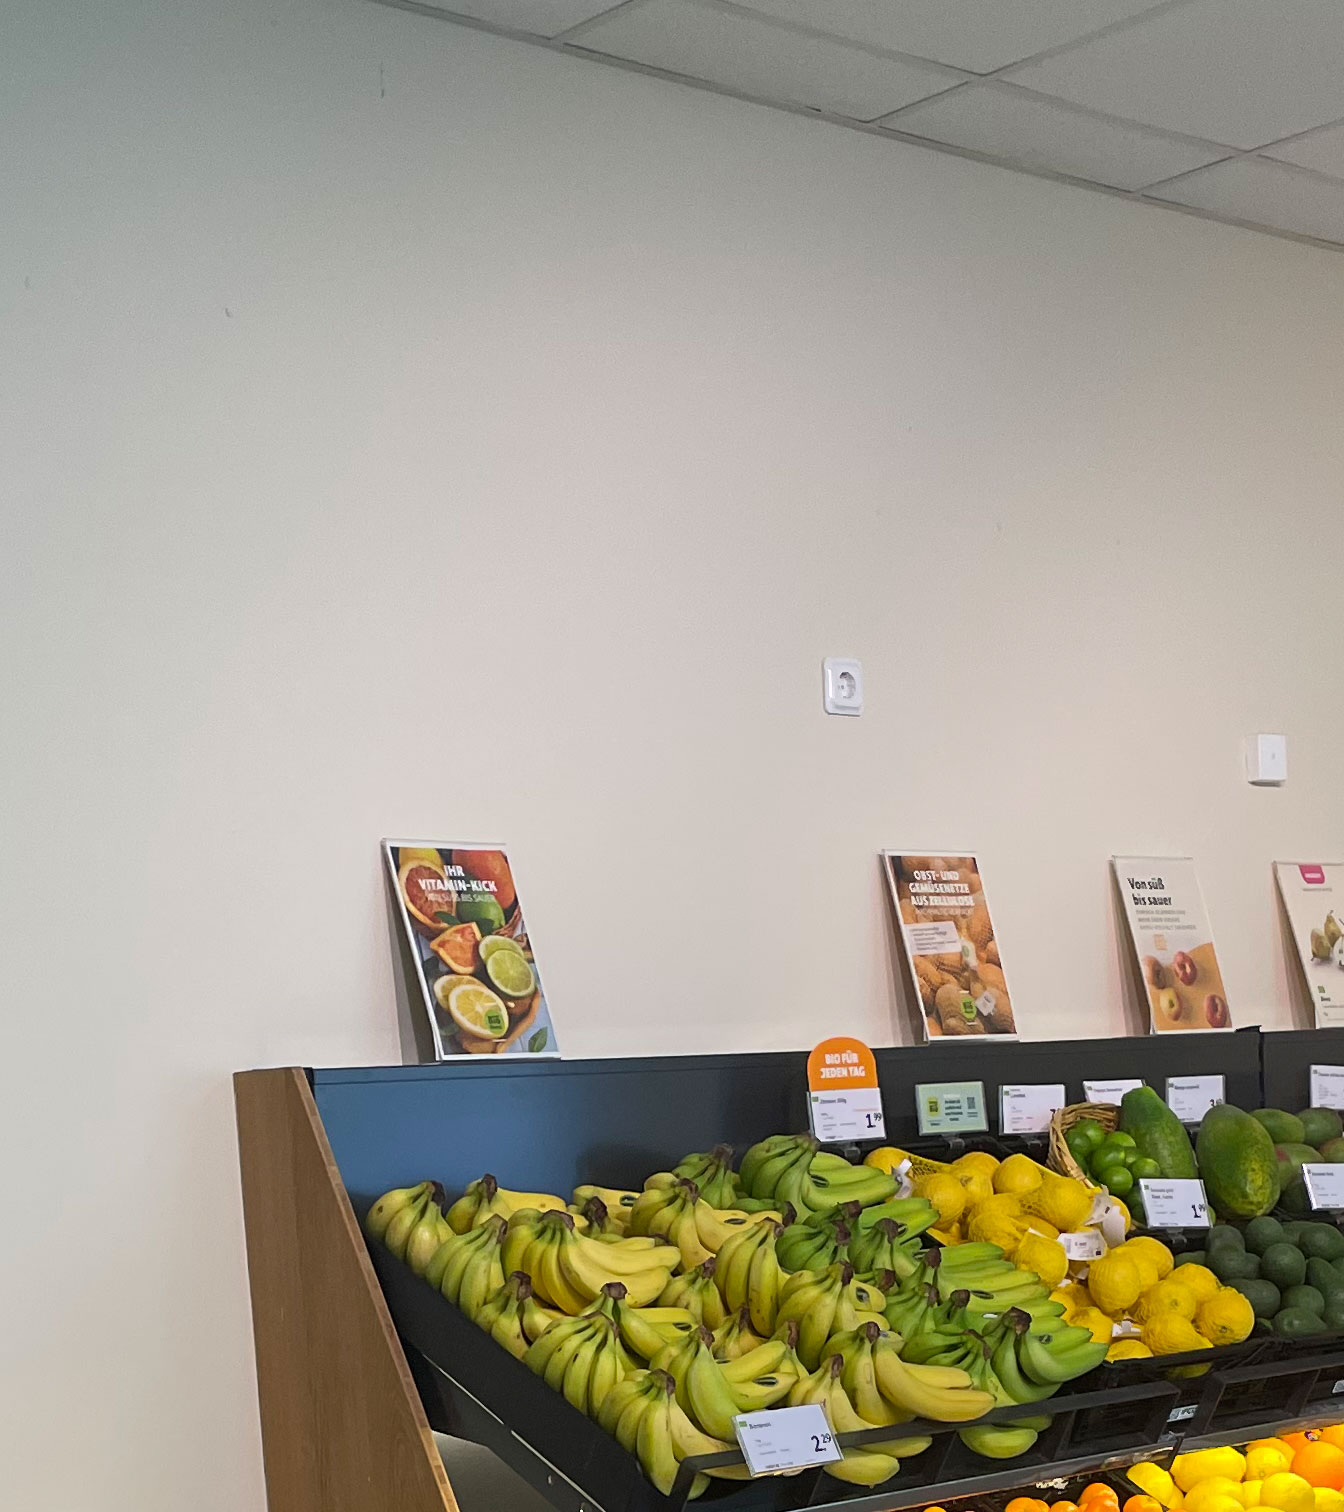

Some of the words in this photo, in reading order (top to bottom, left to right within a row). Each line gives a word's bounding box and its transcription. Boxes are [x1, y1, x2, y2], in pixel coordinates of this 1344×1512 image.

[443, 865, 465, 877] IHR
[913, 870, 940, 881] OBST-
[940, 870, 959, 881] UND
[418, 878, 498, 892] VITAMIN-KICK
[1127, 878, 1147, 890] Von
[1148, 877, 1165, 890] süß
[911, 895, 929, 906] AUS
[1132, 894, 1147, 906] bis
[1148, 896, 1172, 906] sauer
[825, 1053, 842, 1065] BIO
[842, 1050, 859, 1064] FÜR
[820, 1067, 847, 1079] JEDEN
[848, 1066, 865, 1077] TAG
